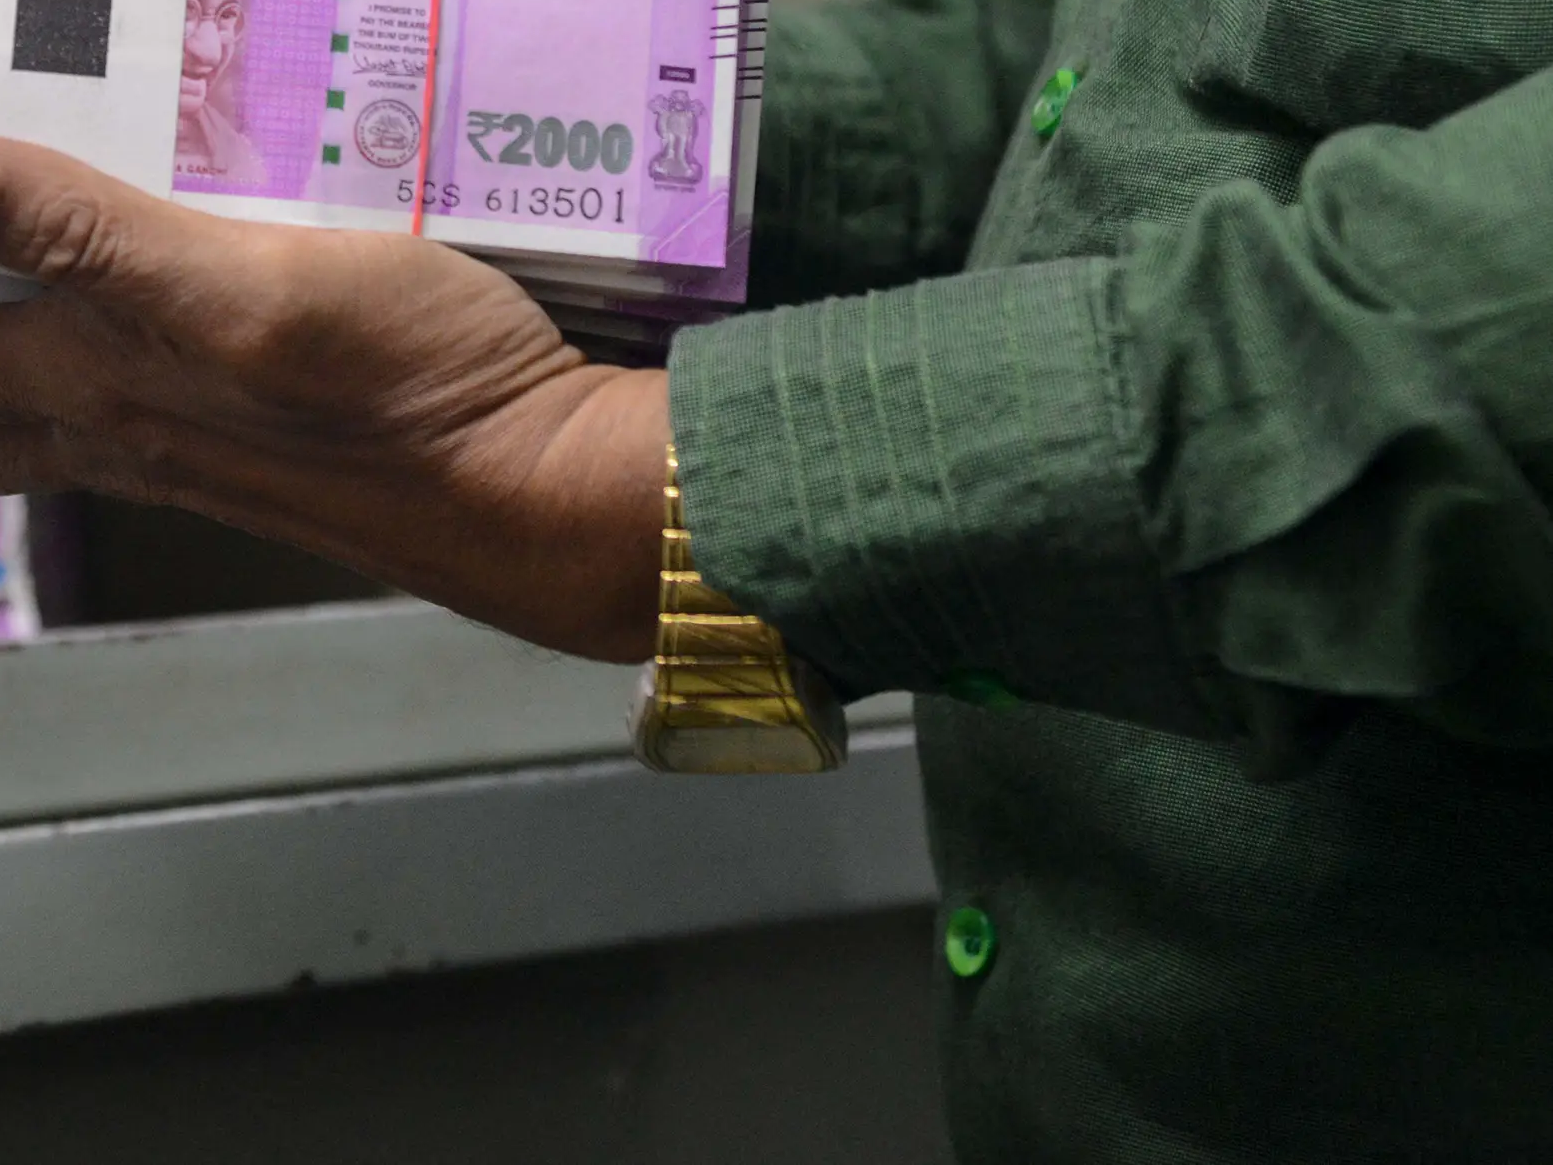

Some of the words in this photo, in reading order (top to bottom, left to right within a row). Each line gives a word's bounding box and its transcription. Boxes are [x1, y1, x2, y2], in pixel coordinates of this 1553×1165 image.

[413, 35, 430, 44] TW
[467, 110, 634, 175] ₹2000
[397, 179, 461, 208] 5CS
[485, 187, 625, 224] 613501
